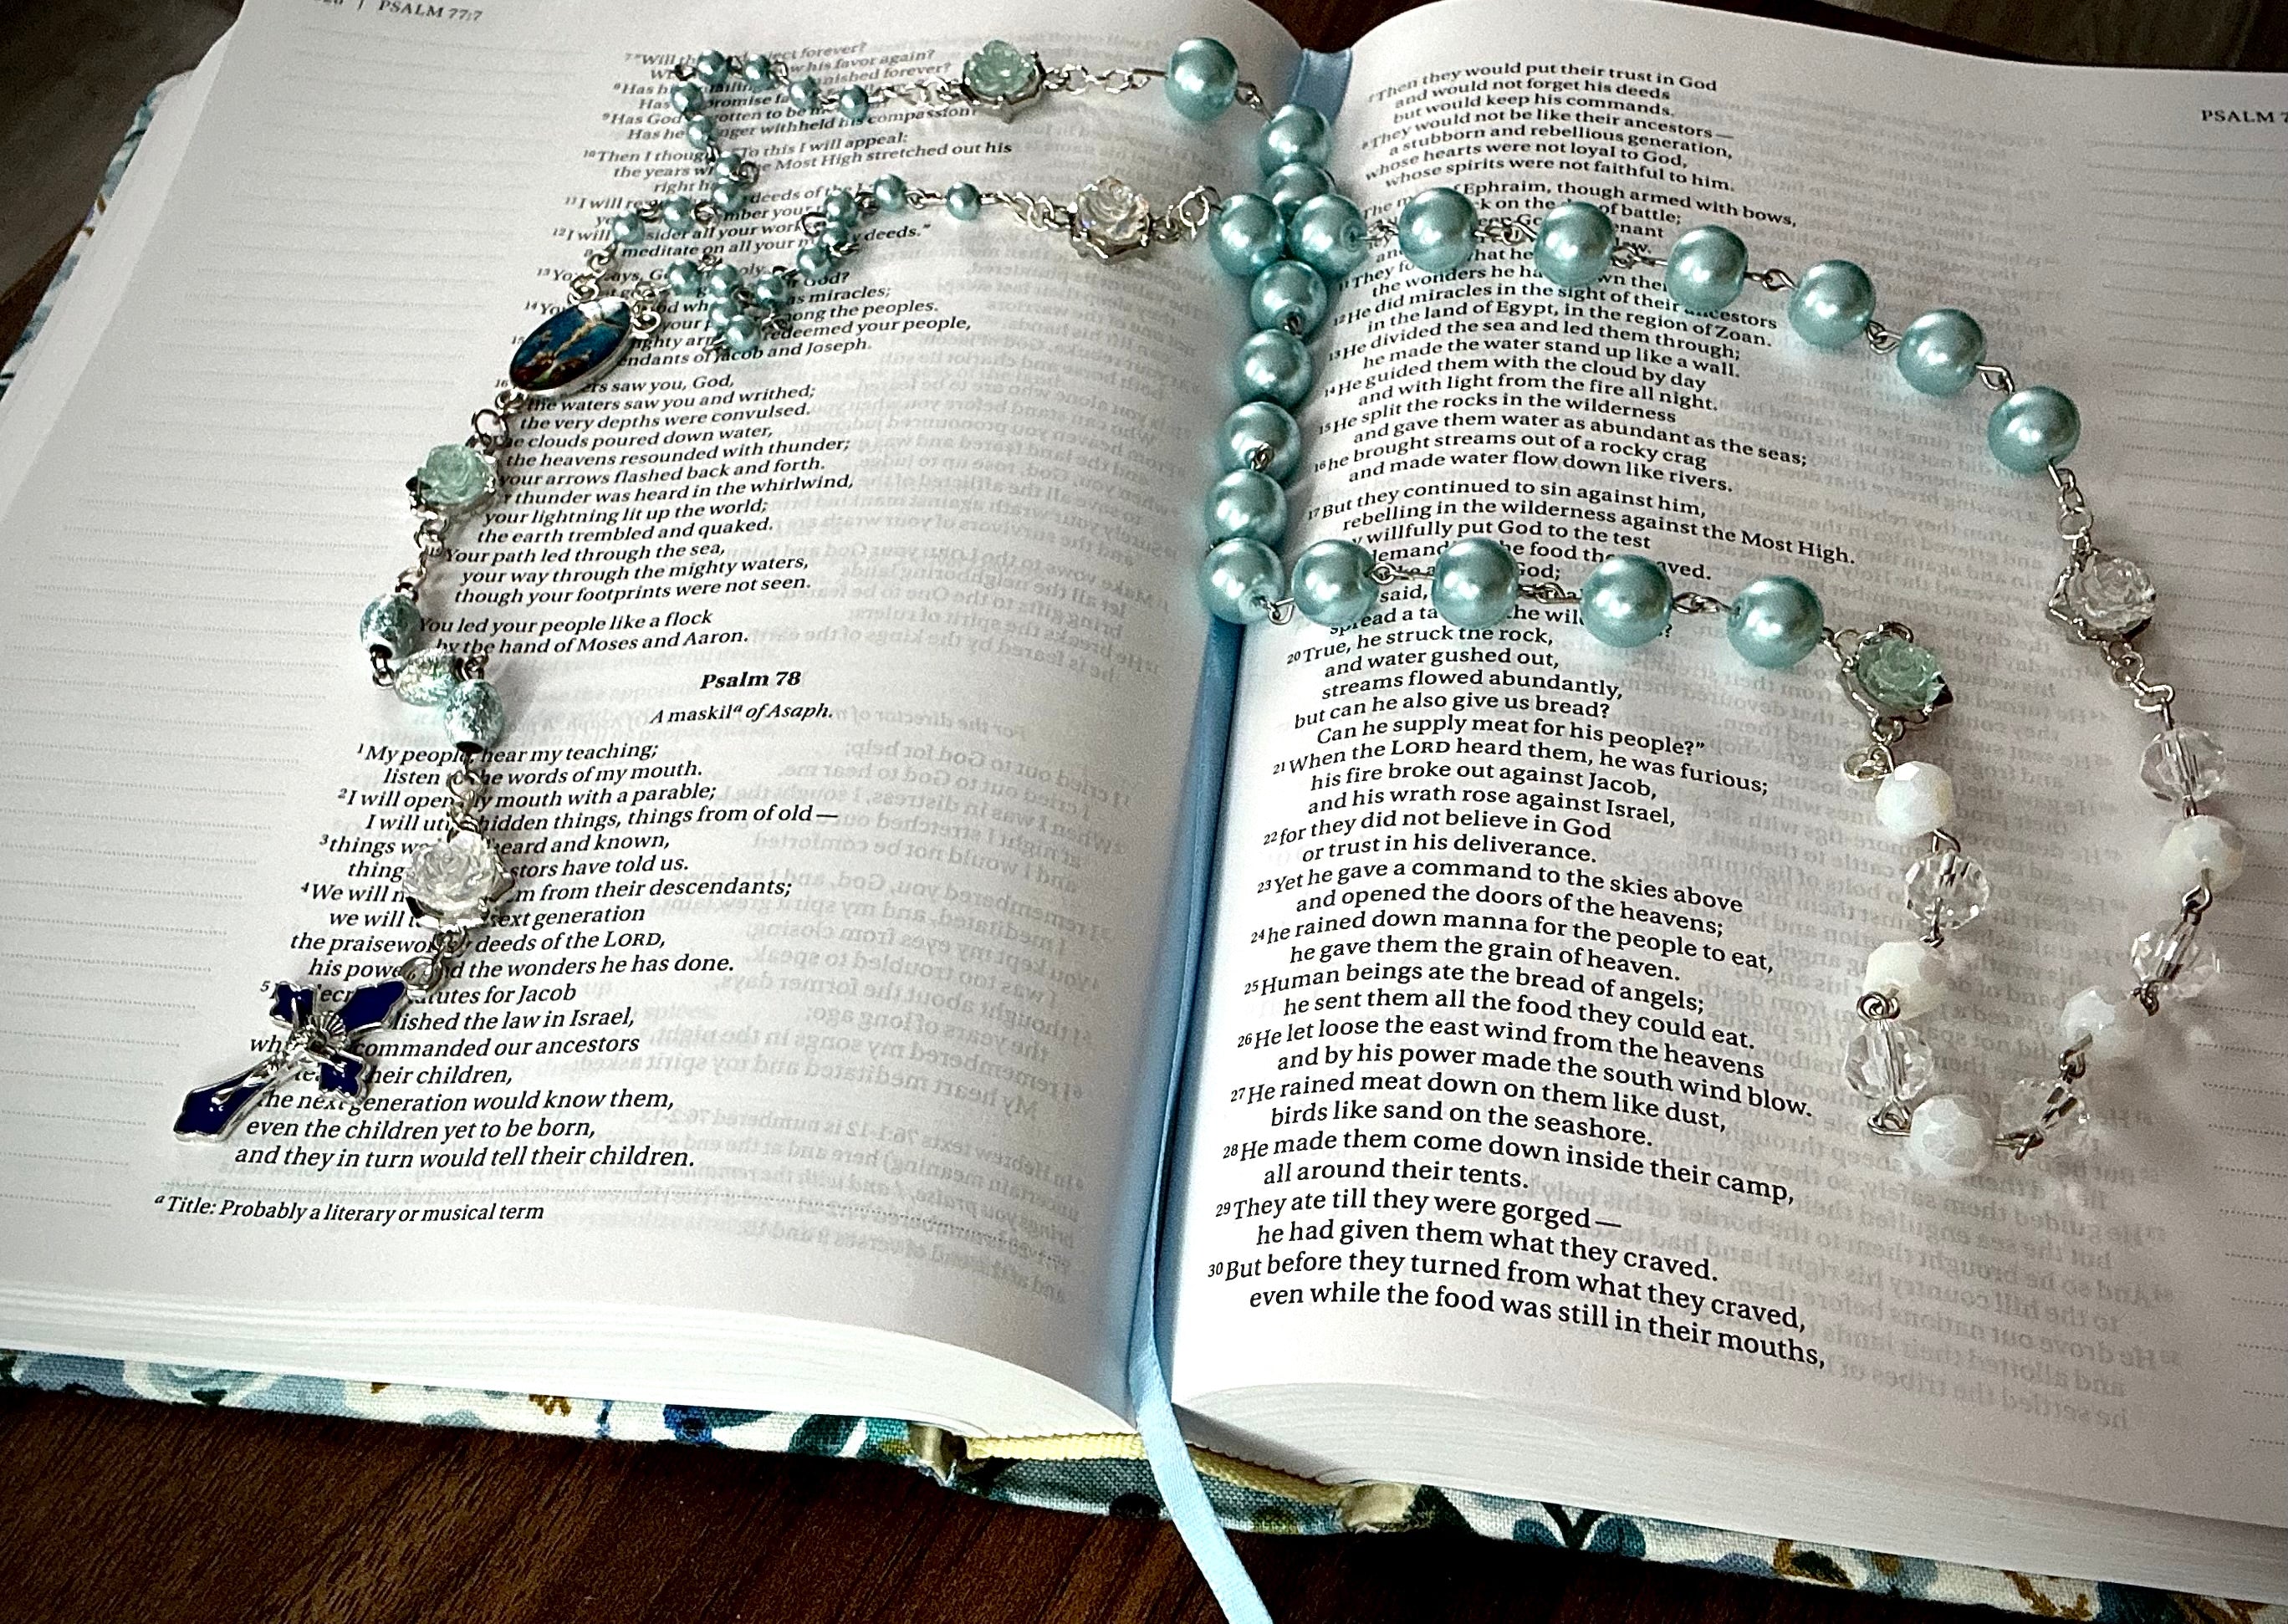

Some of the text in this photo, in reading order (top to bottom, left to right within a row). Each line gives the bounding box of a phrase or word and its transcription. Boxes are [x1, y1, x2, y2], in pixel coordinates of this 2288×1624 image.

[379, 0, 445, 18] PSALM
[1395, 77, 1671, 109] and would not forget his deeds
[2201, 109, 2275, 124] PSALM
[774, 140, 1013, 171] Most High stretched out his
[1389, 123, 1733, 161] a stubborn and rebellious generation,
[1385, 157, 1735, 192] whose spirits were not faithful to him.
[829, 300, 938, 319] the peoples.
[855, 320, 901, 337] your
[901, 315, 971, 334] people,
[1363, 338, 1740, 379] he made the water stand up like a wall.
[528, 384, 815, 412] the waters saw you and writhed;
[506, 437, 850, 467] the heavens resounded with thunder;
[1353, 412, 1807, 467] and gave them water as abundant as the seas;
[1348, 449, 1734, 493] and made water flow down like rivers.
[483, 498, 769, 528] your lightning lit up the world;
[1342, 498, 1856, 565] rebelling in the wilderness against the Most High.
[454, 578, 811, 609] though your footprints were not seen.
[699, 670, 802, 690] Psalm 78
[1321, 668, 1625, 702] streams flowed abundantly,
[1316, 726, 1357, 744] Can
[1361, 719, 1388, 737] he
[1392, 713, 1468, 736] supply
[1471, 718, 1530, 734] meat
[1533, 717, 1566, 738] for
[1569, 720, 1604, 743] his
[1307, 784, 1675, 828] and his wrath rose against Israel,
[1296, 882, 1724, 938] and opened the doors of the heavens;
[1283, 988, 1754, 1050] he sent them all the food they could eat.
[246, 1116, 595, 1146] even the children yet to be born,
[1270, 1099, 1654, 1147] birds like sand on the seashore.
[234, 1144, 694, 1172] and they in turn would tell their children.
[1264, 1157, 1530, 1189] all around their tents.
[166, 1195, 544, 1228] Title: Probably a literary or musical term
[1249, 1280, 1825, 1370] even while the food was still in their mouths,
